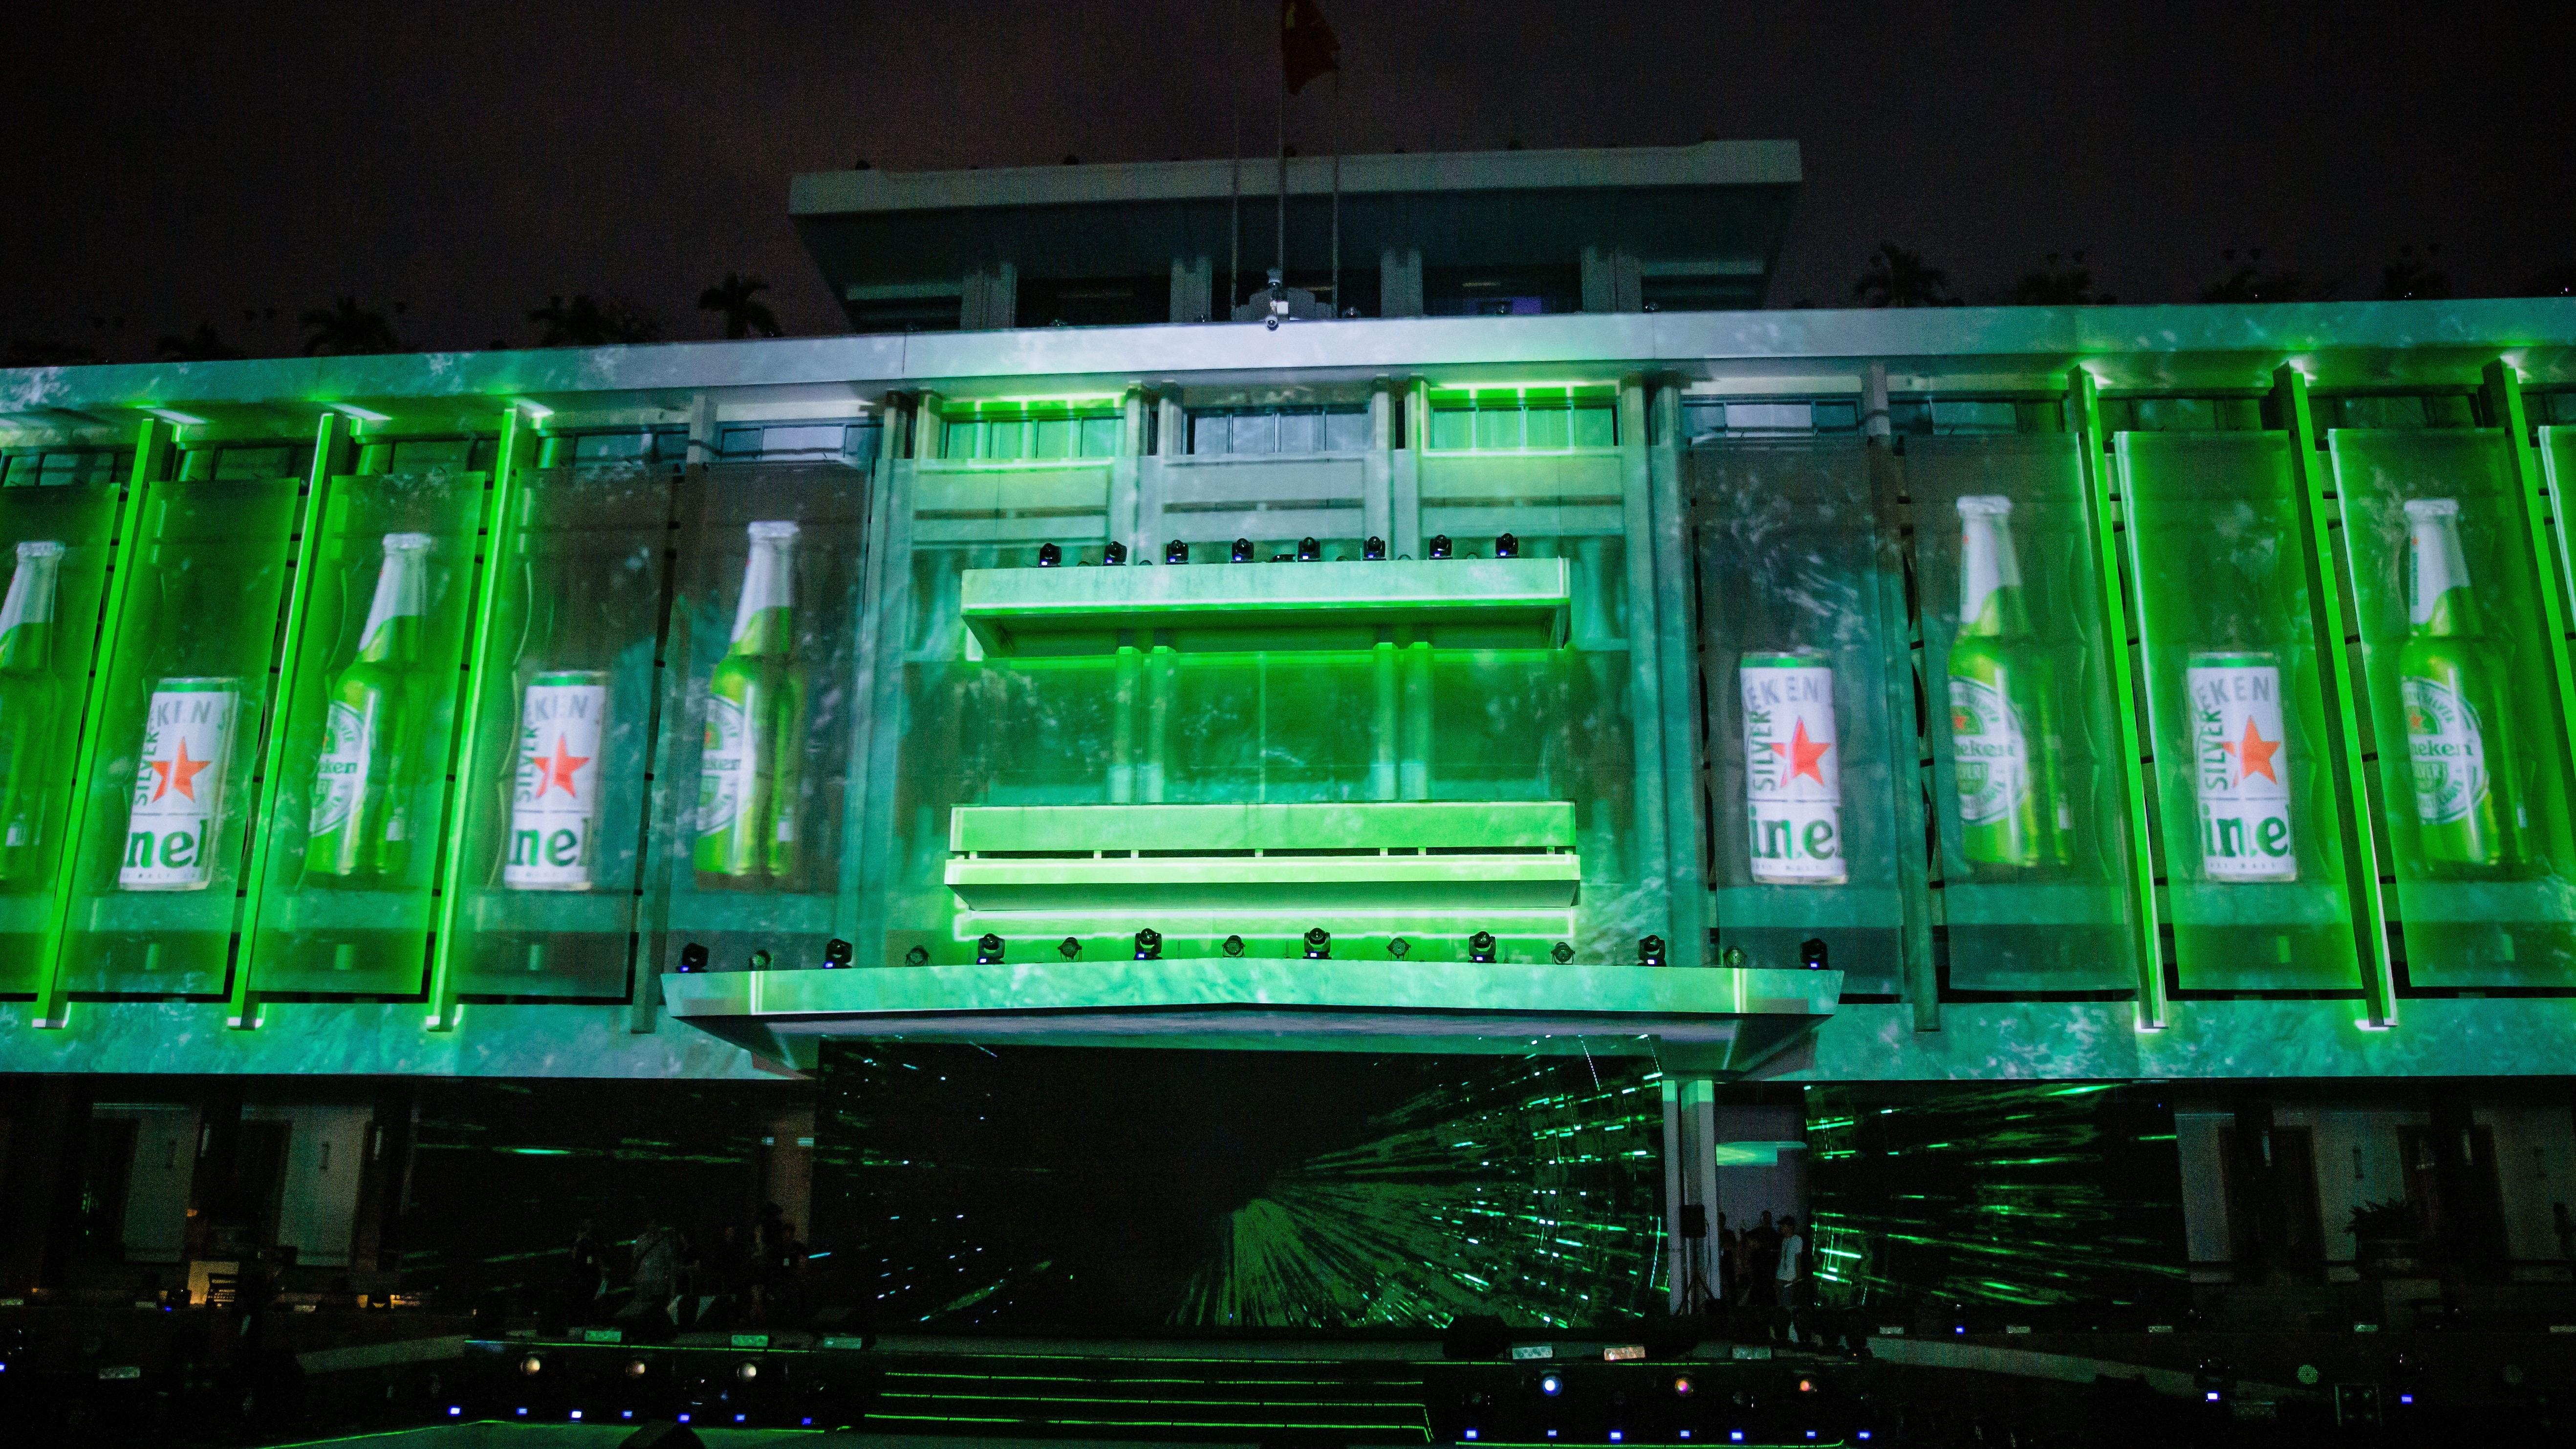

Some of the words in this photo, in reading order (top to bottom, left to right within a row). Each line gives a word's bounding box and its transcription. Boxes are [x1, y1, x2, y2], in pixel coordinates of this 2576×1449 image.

[134, 732, 160, 806] SILVER
[1748, 711, 1775, 791] SILVER
[2199, 710, 2228, 790] SILVER
